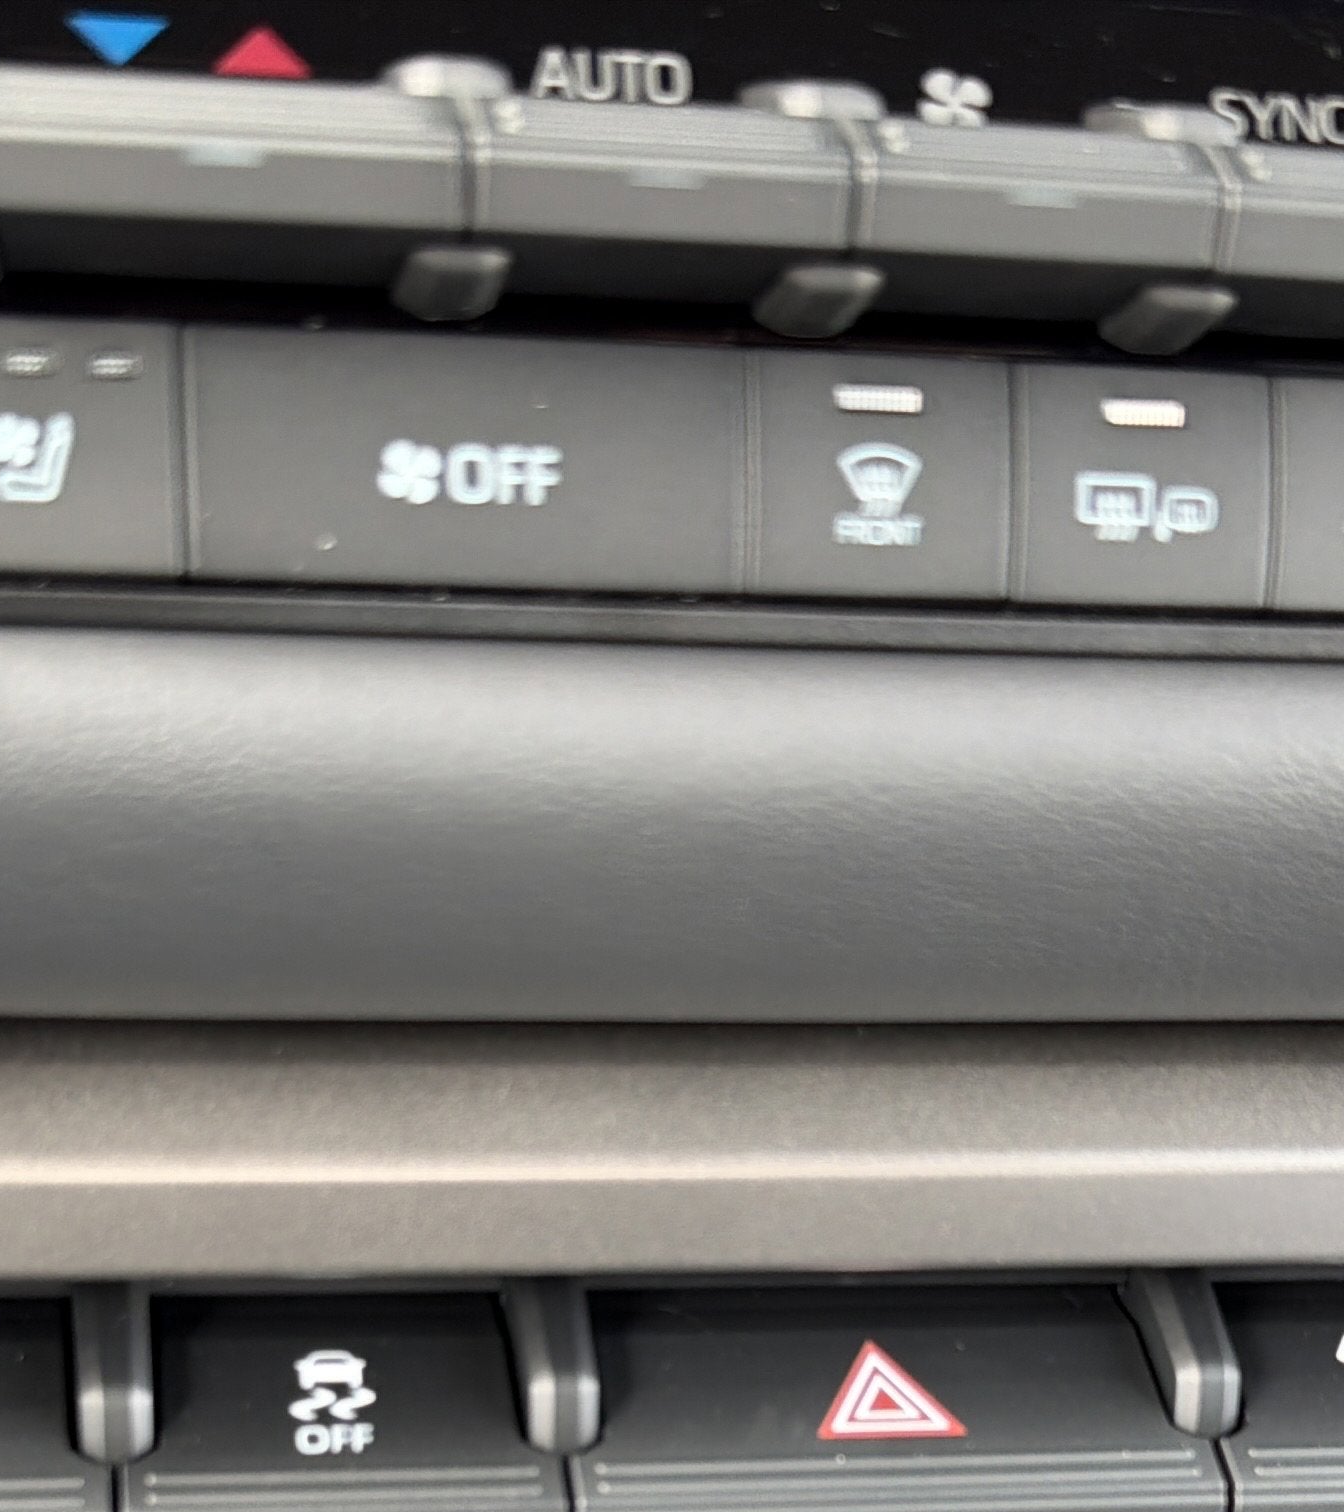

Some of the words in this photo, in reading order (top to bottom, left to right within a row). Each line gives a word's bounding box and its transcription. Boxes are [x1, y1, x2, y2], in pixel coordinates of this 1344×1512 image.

[530, 46, 693, 104] AUTO
[446, 443, 563, 506] OFF
[833, 511, 925, 546] FRONT
[294, 1422, 375, 1456] OFF
